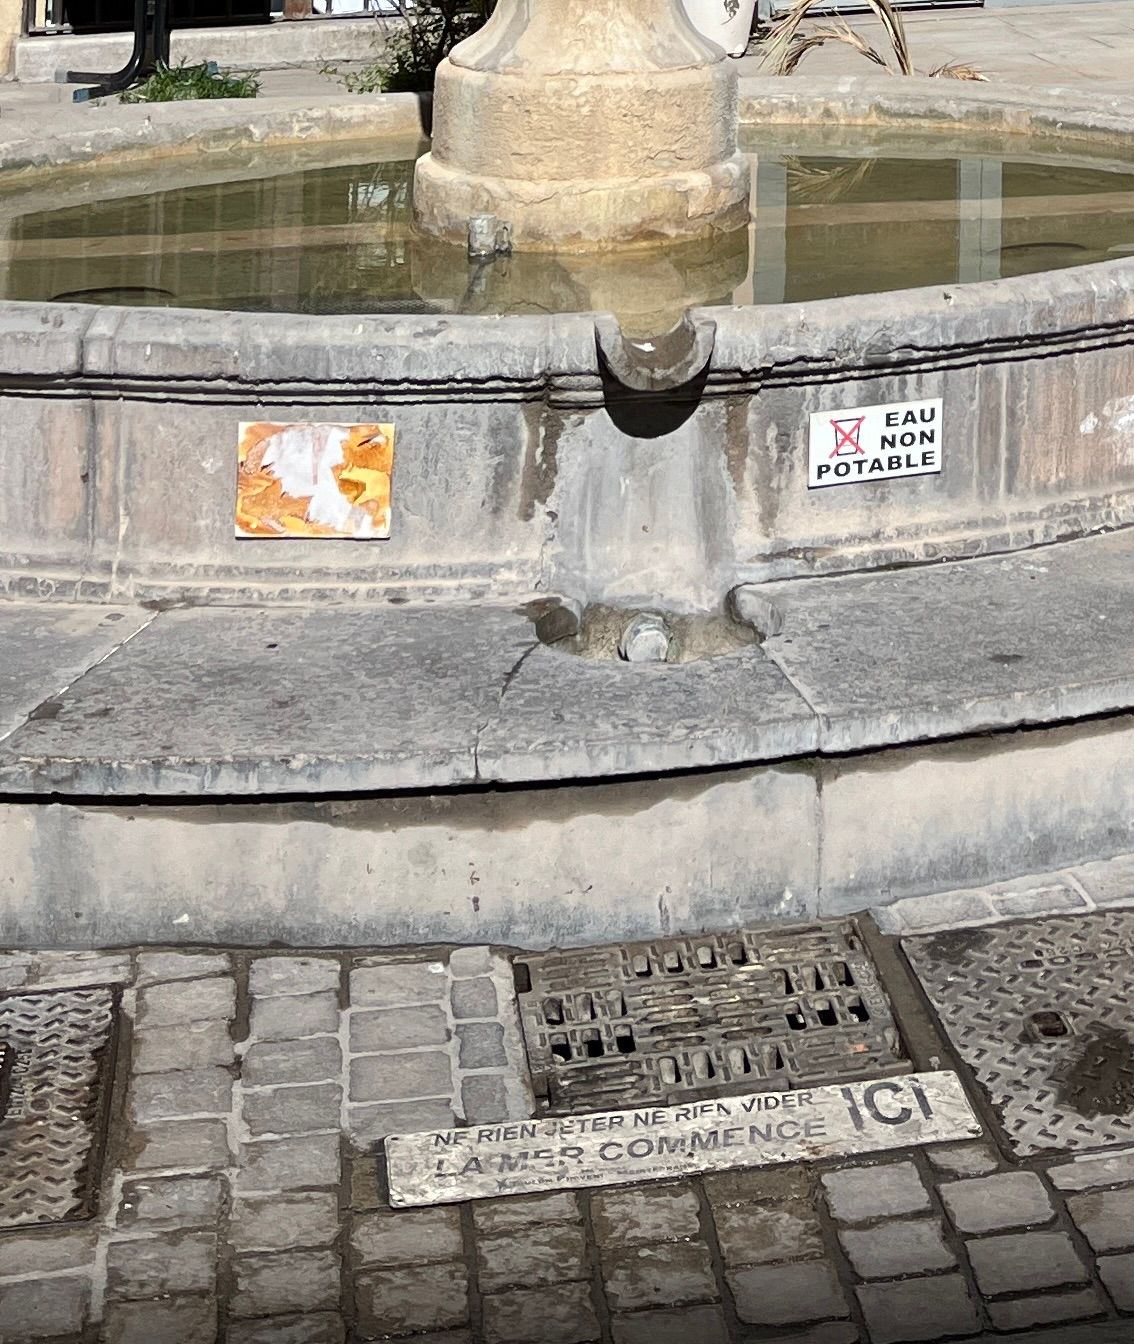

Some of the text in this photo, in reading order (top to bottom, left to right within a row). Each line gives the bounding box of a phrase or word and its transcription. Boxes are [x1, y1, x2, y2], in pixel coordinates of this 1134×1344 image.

[885, 407, 936, 427] EAU
[880, 429, 936, 450] NON
[816, 450, 936, 480] POTABLE
[477, 1123, 537, 1144] RIEN
[544, 1115, 625, 1137] JETER
[633, 1110, 667, 1128] NE
[741, 1092, 814, 1113] VIDER
[841, 1077, 933, 1132] ICI
[433, 1156, 484, 1178] LA
[599, 1116, 827, 1162] COMMENCE
